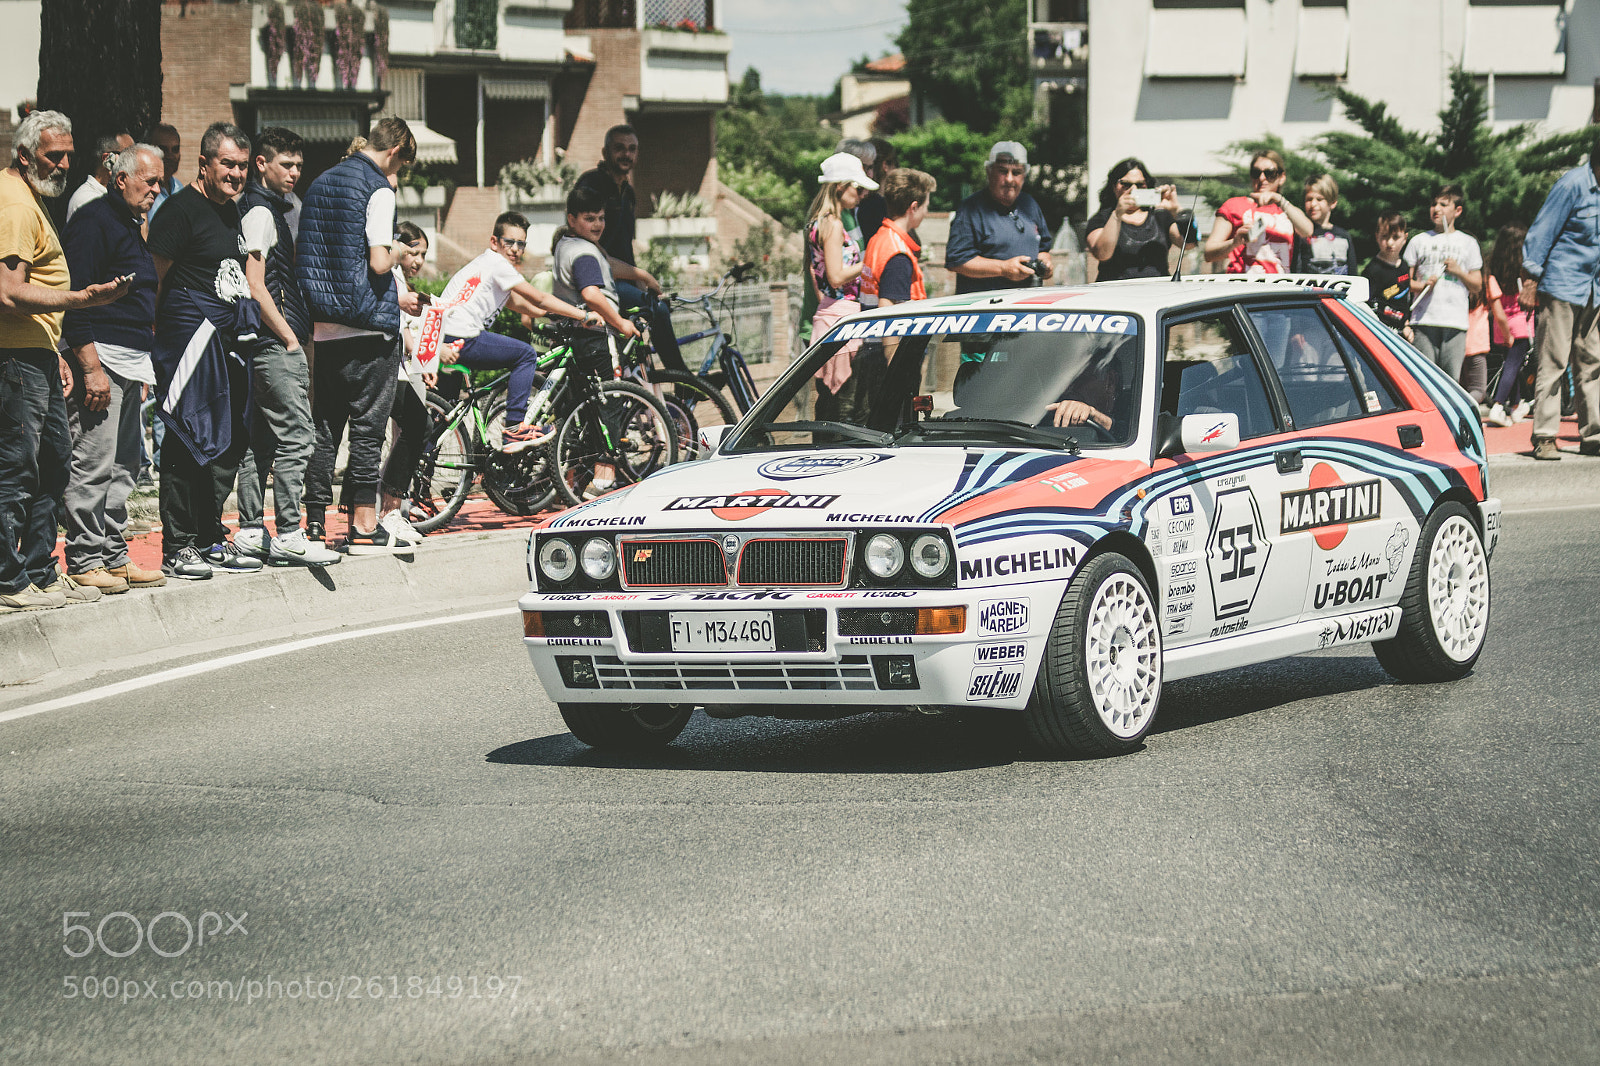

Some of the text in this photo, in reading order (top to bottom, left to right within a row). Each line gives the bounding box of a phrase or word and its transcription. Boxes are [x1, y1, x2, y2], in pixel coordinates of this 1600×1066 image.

[834, 314, 1130, 341] MARTINI RACING
[670, 495, 834, 509] MARTINI
[1174, 497, 1190, 513] ERG
[1283, 483, 1379, 530] MARTINI
[566, 516, 646, 527] MICHELIN
[826, 513, 917, 524] MICHELIN
[1168, 519, 1194, 534] CECOMP
[960, 546, 1077, 581] MICHELIN
[1168, 582, 1195, 598] brembo
[1313, 573, 1388, 610] U-BOAT
[981, 601, 1028, 622] MAGNETI
[672, 620, 772, 643] FI M34460
[981, 612, 1028, 633] MARELLI
[1331, 607, 1394, 645] Mistral
[977, 645, 1025, 660] WEBER
[969, 667, 1021, 698] SELENIA
